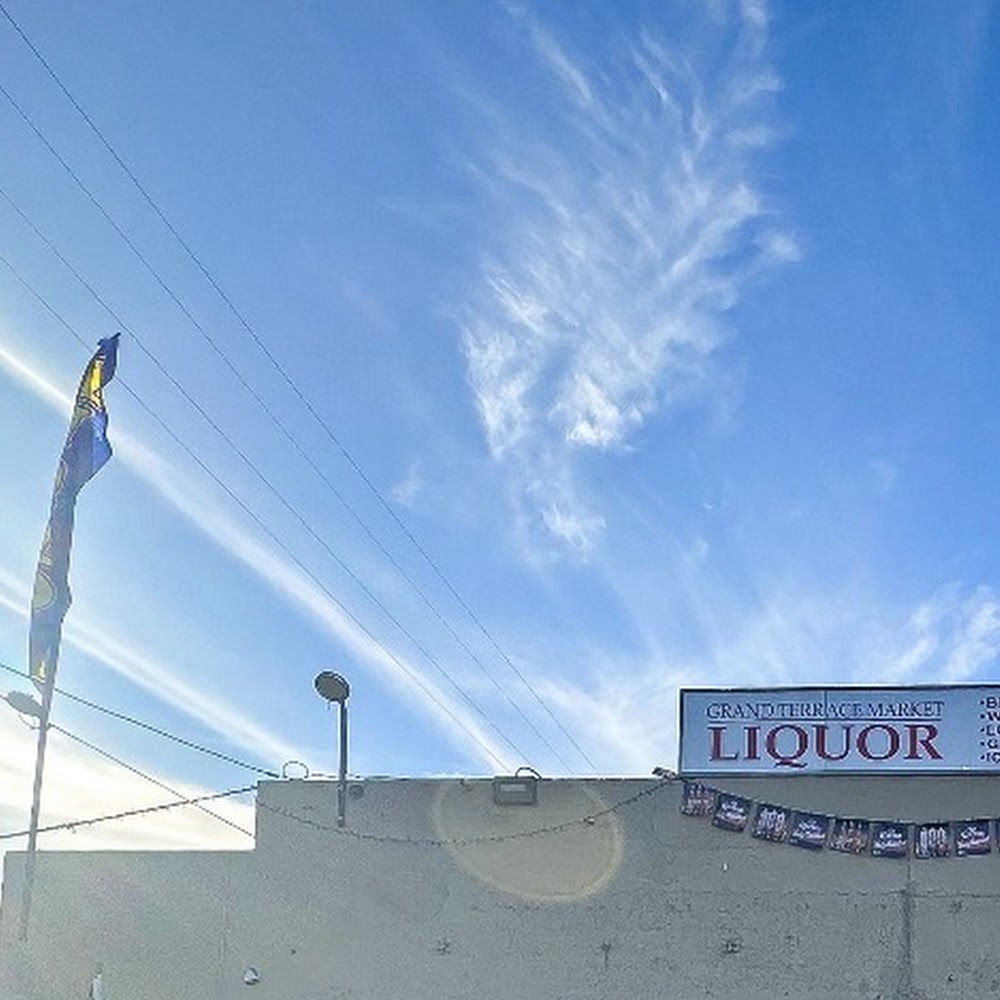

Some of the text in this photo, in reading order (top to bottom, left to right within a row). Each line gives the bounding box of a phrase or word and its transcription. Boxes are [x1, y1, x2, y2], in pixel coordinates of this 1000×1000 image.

[706, 701, 944, 719] GRAND TERRACE MARKET
[707, 724, 943, 768] LIQUOR
